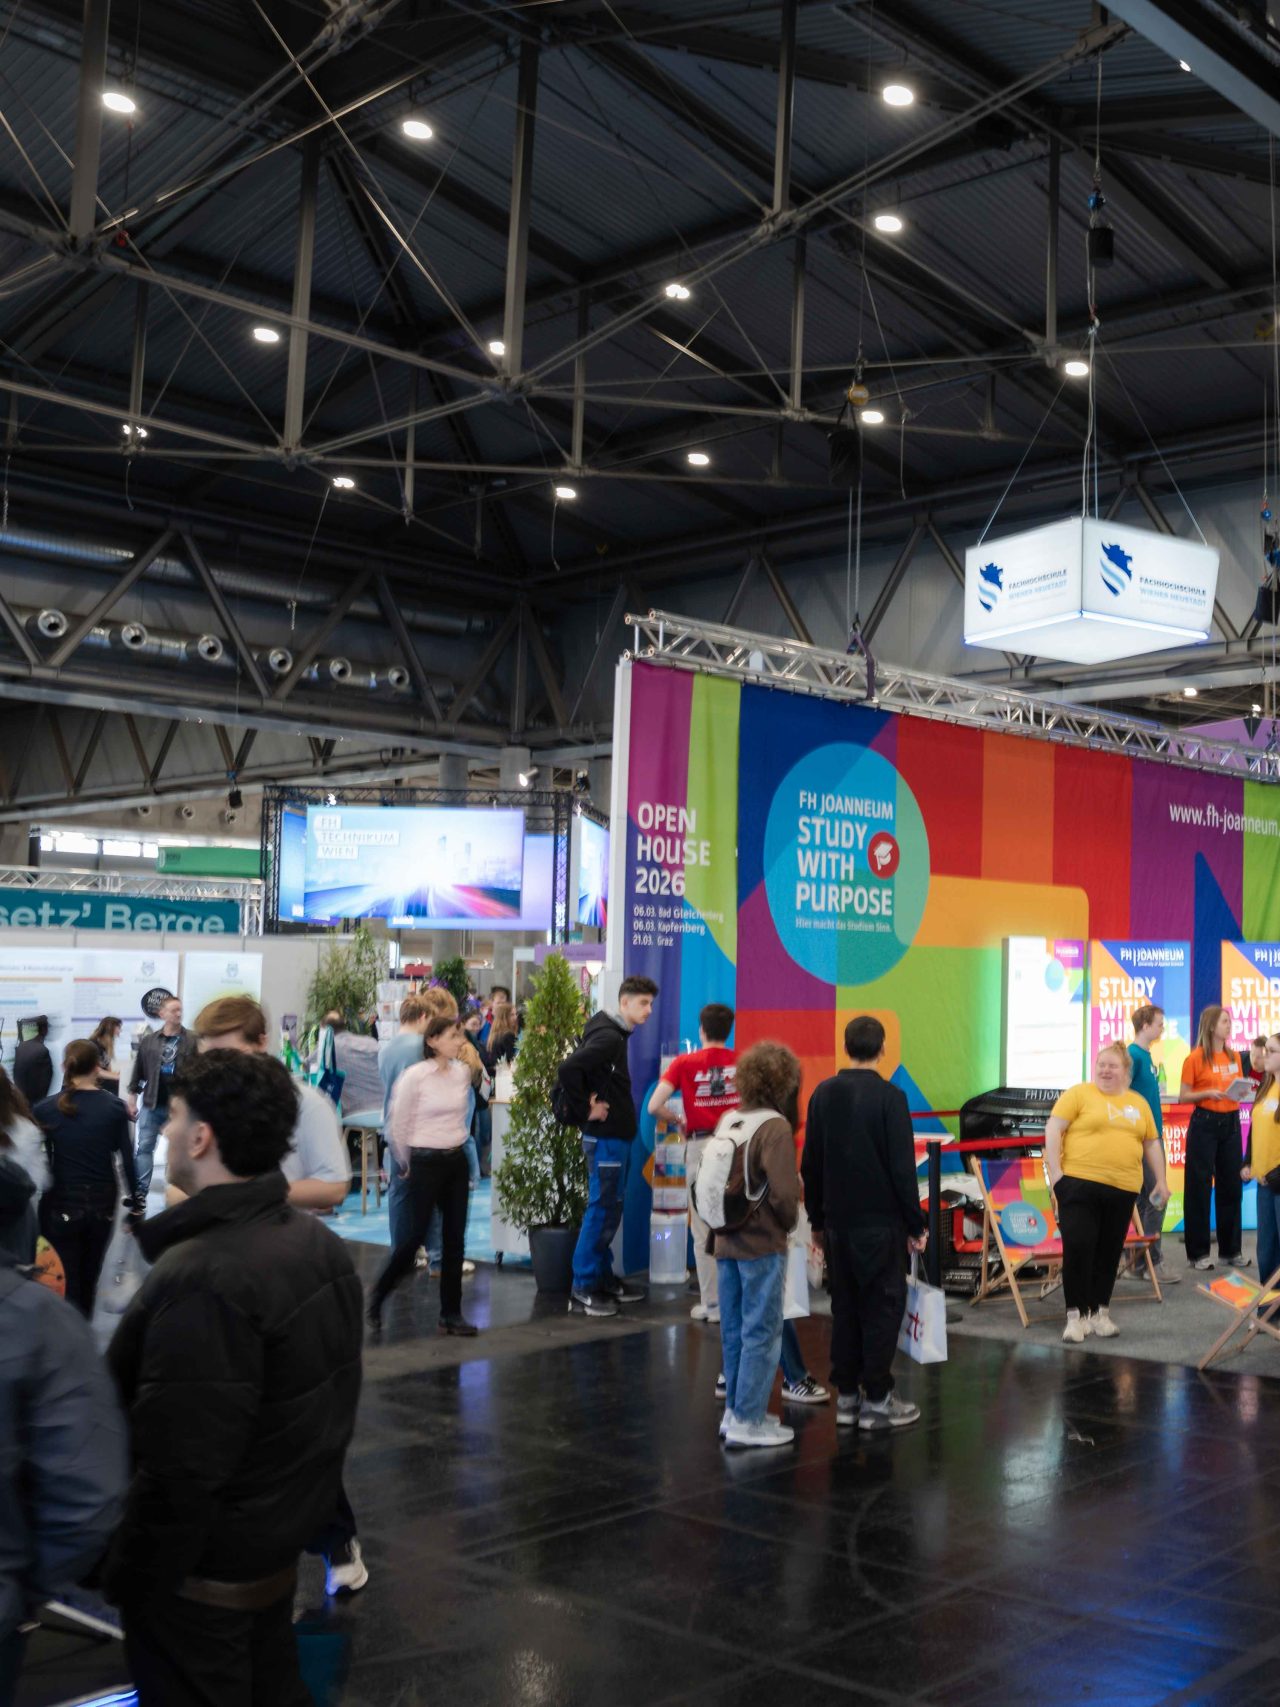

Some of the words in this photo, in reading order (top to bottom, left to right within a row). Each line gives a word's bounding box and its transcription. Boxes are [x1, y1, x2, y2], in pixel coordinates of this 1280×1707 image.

[1009, 569, 1067, 589] FACHHOCHSCHULE
[1139, 577, 1206, 596] FACHHOCHSCHULE
[799, 790, 817, 810] FH
[820, 794, 894, 820] JOANNEUM
[321, 817, 338, 827] FH
[637, 802, 698, 833] OPEN
[321, 832, 395, 844] TECHNIKUM
[798, 815, 868, 850] STUDY
[321, 847, 354, 857] WIEN
[636, 834, 711, 867] HOUSE
[797, 848, 855, 881] WITH
[635, 867, 686, 897] 2026
[796, 880, 893, 916] PURPOSE
[105, 904, 225, 933] Berge
[658, 906, 672, 918] Bad
[658, 922, 706, 937] Kapfenberg
[657, 936, 674, 946] Graz
[1120, 948, 1132, 961] FH
[1137, 948, 1184, 962] JOANNEUM
[1254, 948, 1268, 961] FH
[1099, 977, 1157, 998] STUDY
[1099, 1019, 1178, 1041] PURE
